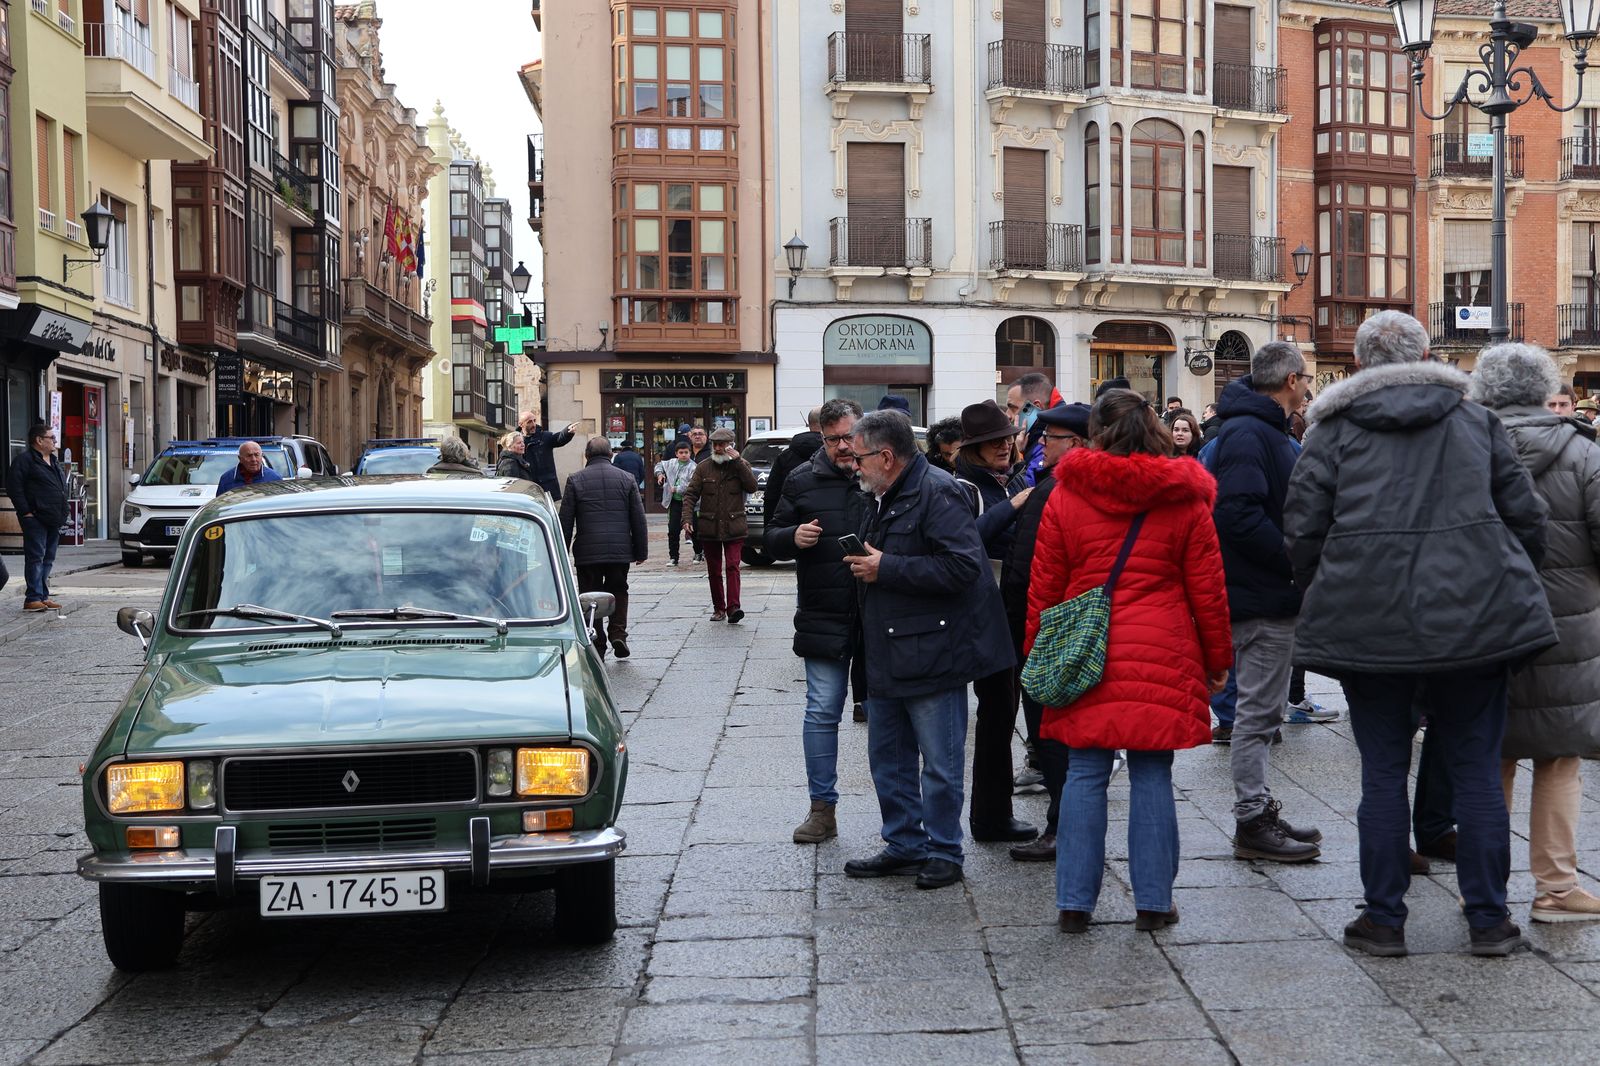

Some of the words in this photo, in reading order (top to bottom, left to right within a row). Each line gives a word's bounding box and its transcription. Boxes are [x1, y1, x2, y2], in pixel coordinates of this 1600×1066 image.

[838, 323, 914, 336] ORTOPEDIA
[838, 338, 915, 350] ZAMORANA
[631, 375, 718, 389] FARMACIA
